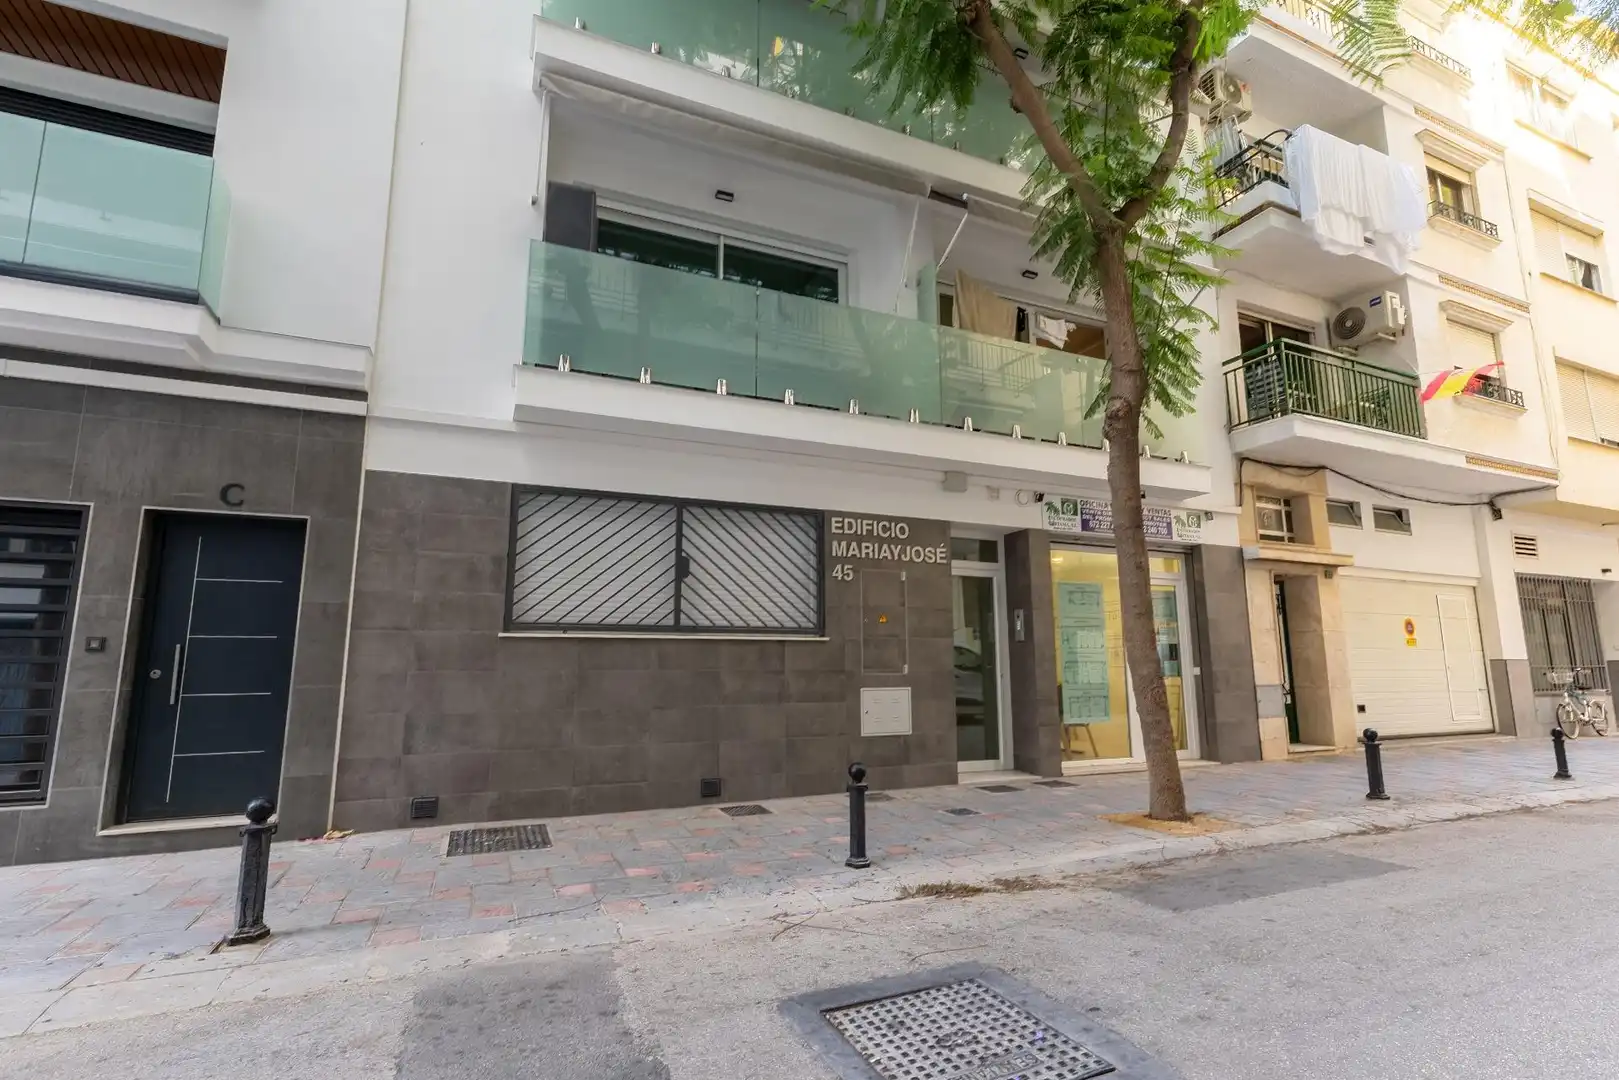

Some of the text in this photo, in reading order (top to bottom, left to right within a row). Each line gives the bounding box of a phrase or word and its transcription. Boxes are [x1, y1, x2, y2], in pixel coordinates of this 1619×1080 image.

[220, 483, 245, 507] C
[1079, 499, 1109, 511] OFICINA
[1148, 507, 1172, 516] VENTAS
[831, 516, 909, 539] EDIFICIO
[831, 563, 854, 581] 45
